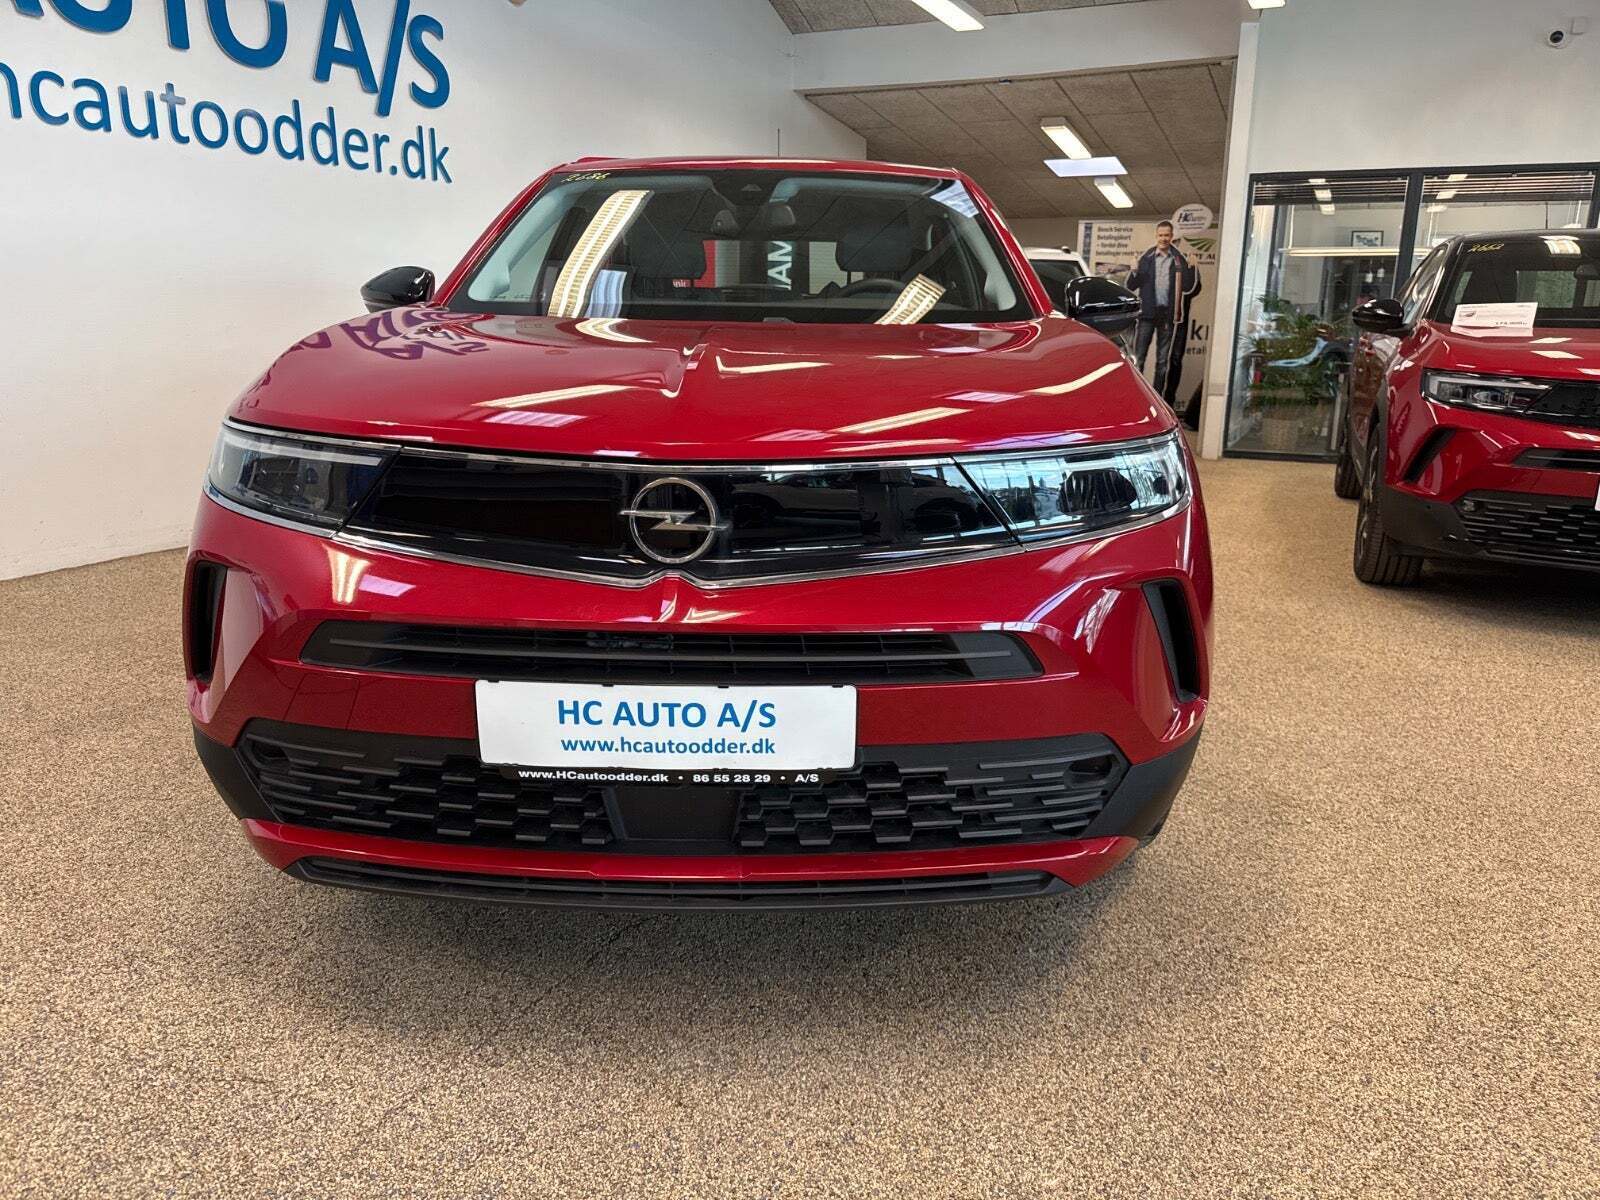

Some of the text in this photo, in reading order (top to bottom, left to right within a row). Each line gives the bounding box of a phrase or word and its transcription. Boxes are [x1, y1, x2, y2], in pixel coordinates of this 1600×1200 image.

[313, 0, 451, 117] A/S
[558, 699, 777, 733] HC AUTO A/S
[560, 736, 776, 755] www.hcautoodder.dk
[517, 769, 820, 783] www.HCautoodder.dk 86 55 28 29 A/S
